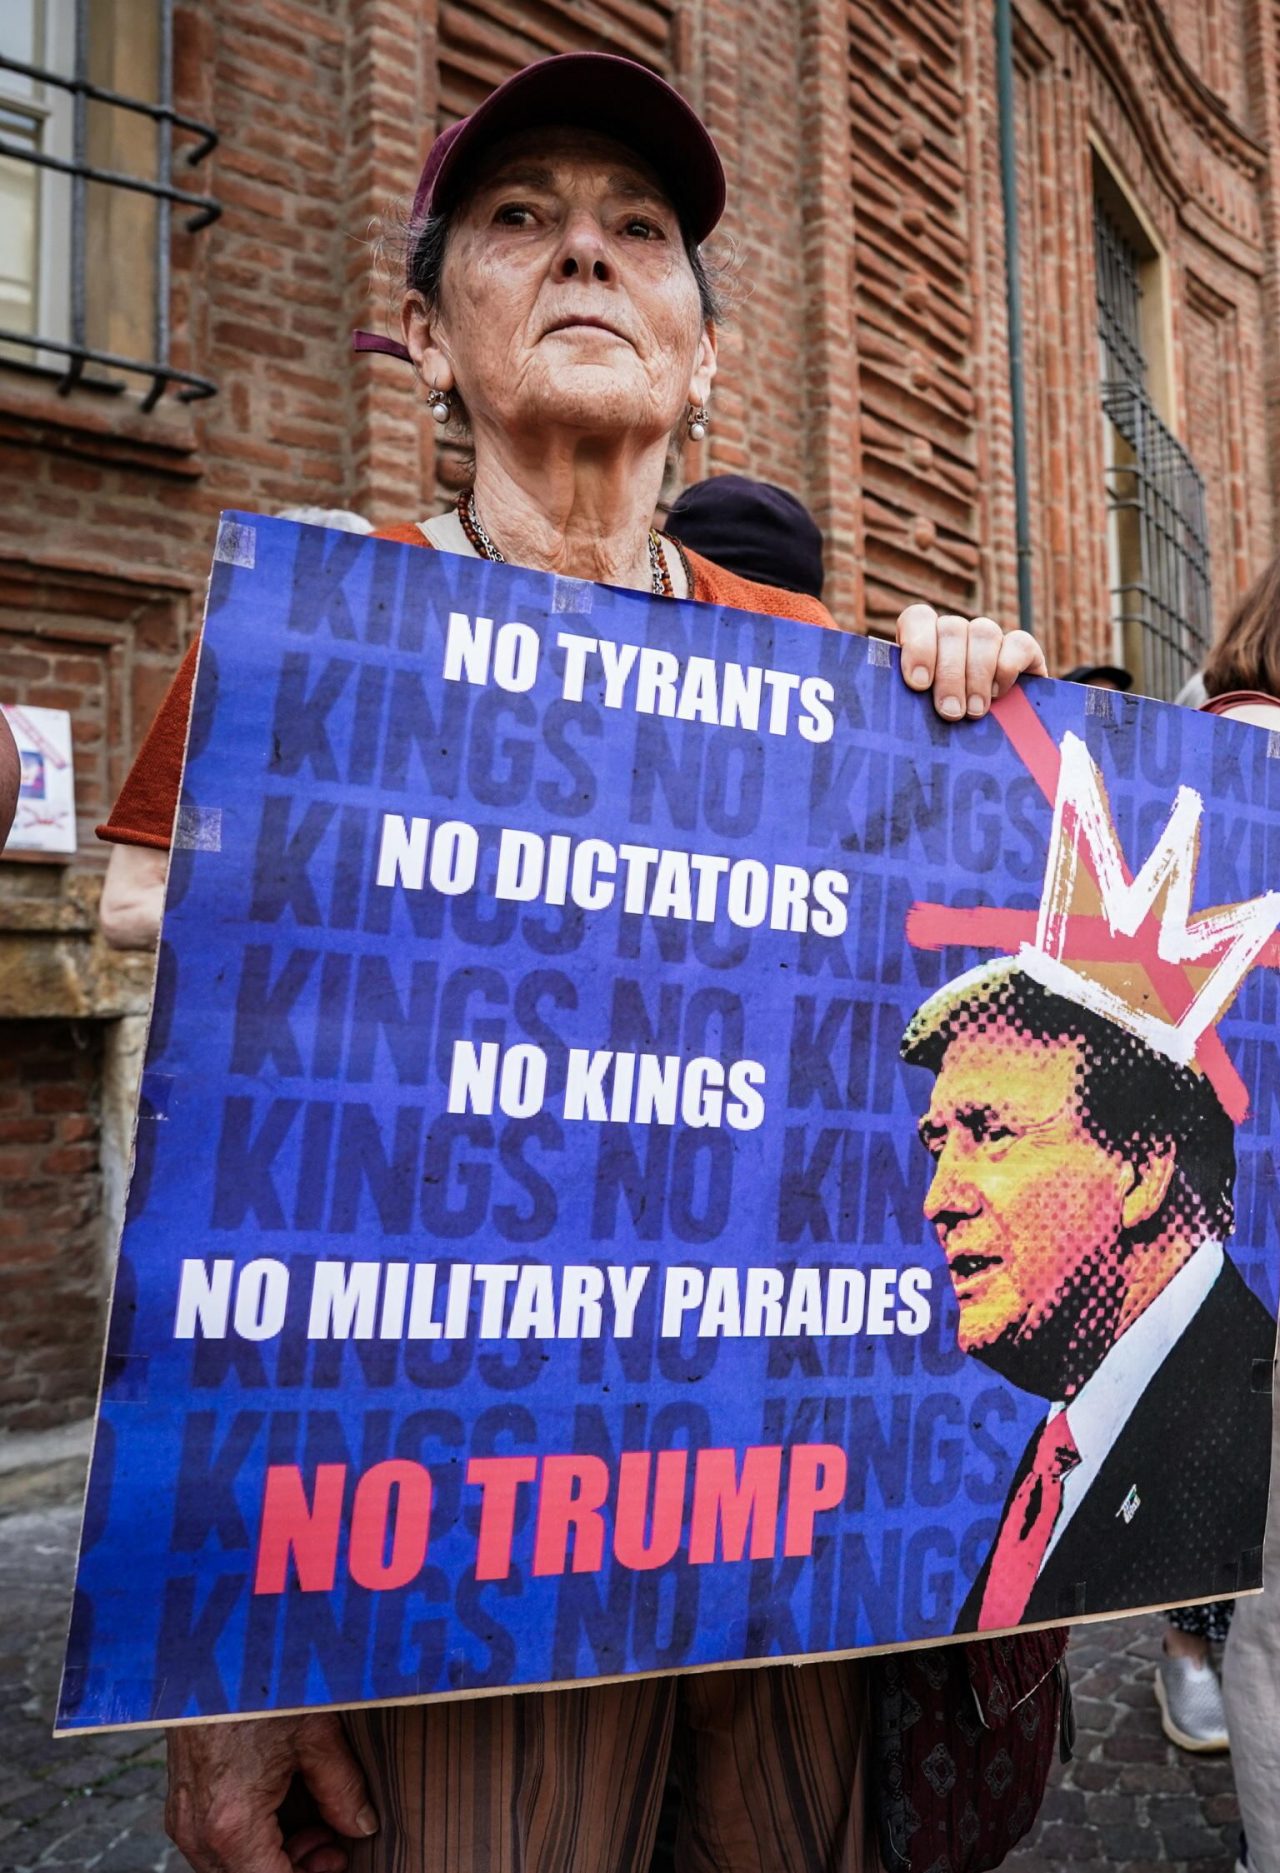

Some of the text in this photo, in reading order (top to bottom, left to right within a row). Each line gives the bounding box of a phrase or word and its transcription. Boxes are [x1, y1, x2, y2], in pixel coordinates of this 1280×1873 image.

[267, 650, 604, 820] KINGS
[442, 612, 835, 743] NO TYRANTS
[375, 813, 479, 896] NO
[495, 828, 849, 937] DICTATORS
[446, 1039, 766, 1132] NO KINGS
[210, 1094, 566, 1243] KINGS
[590, 1122, 735, 1244] NO
[173, 1257, 290, 1341] NO
[306, 1260, 651, 1340] MILITARY
[660, 1265, 933, 1339] PARADES
[253, 1458, 433, 1595] NO
[465, 1443, 848, 1582] TRUMP
